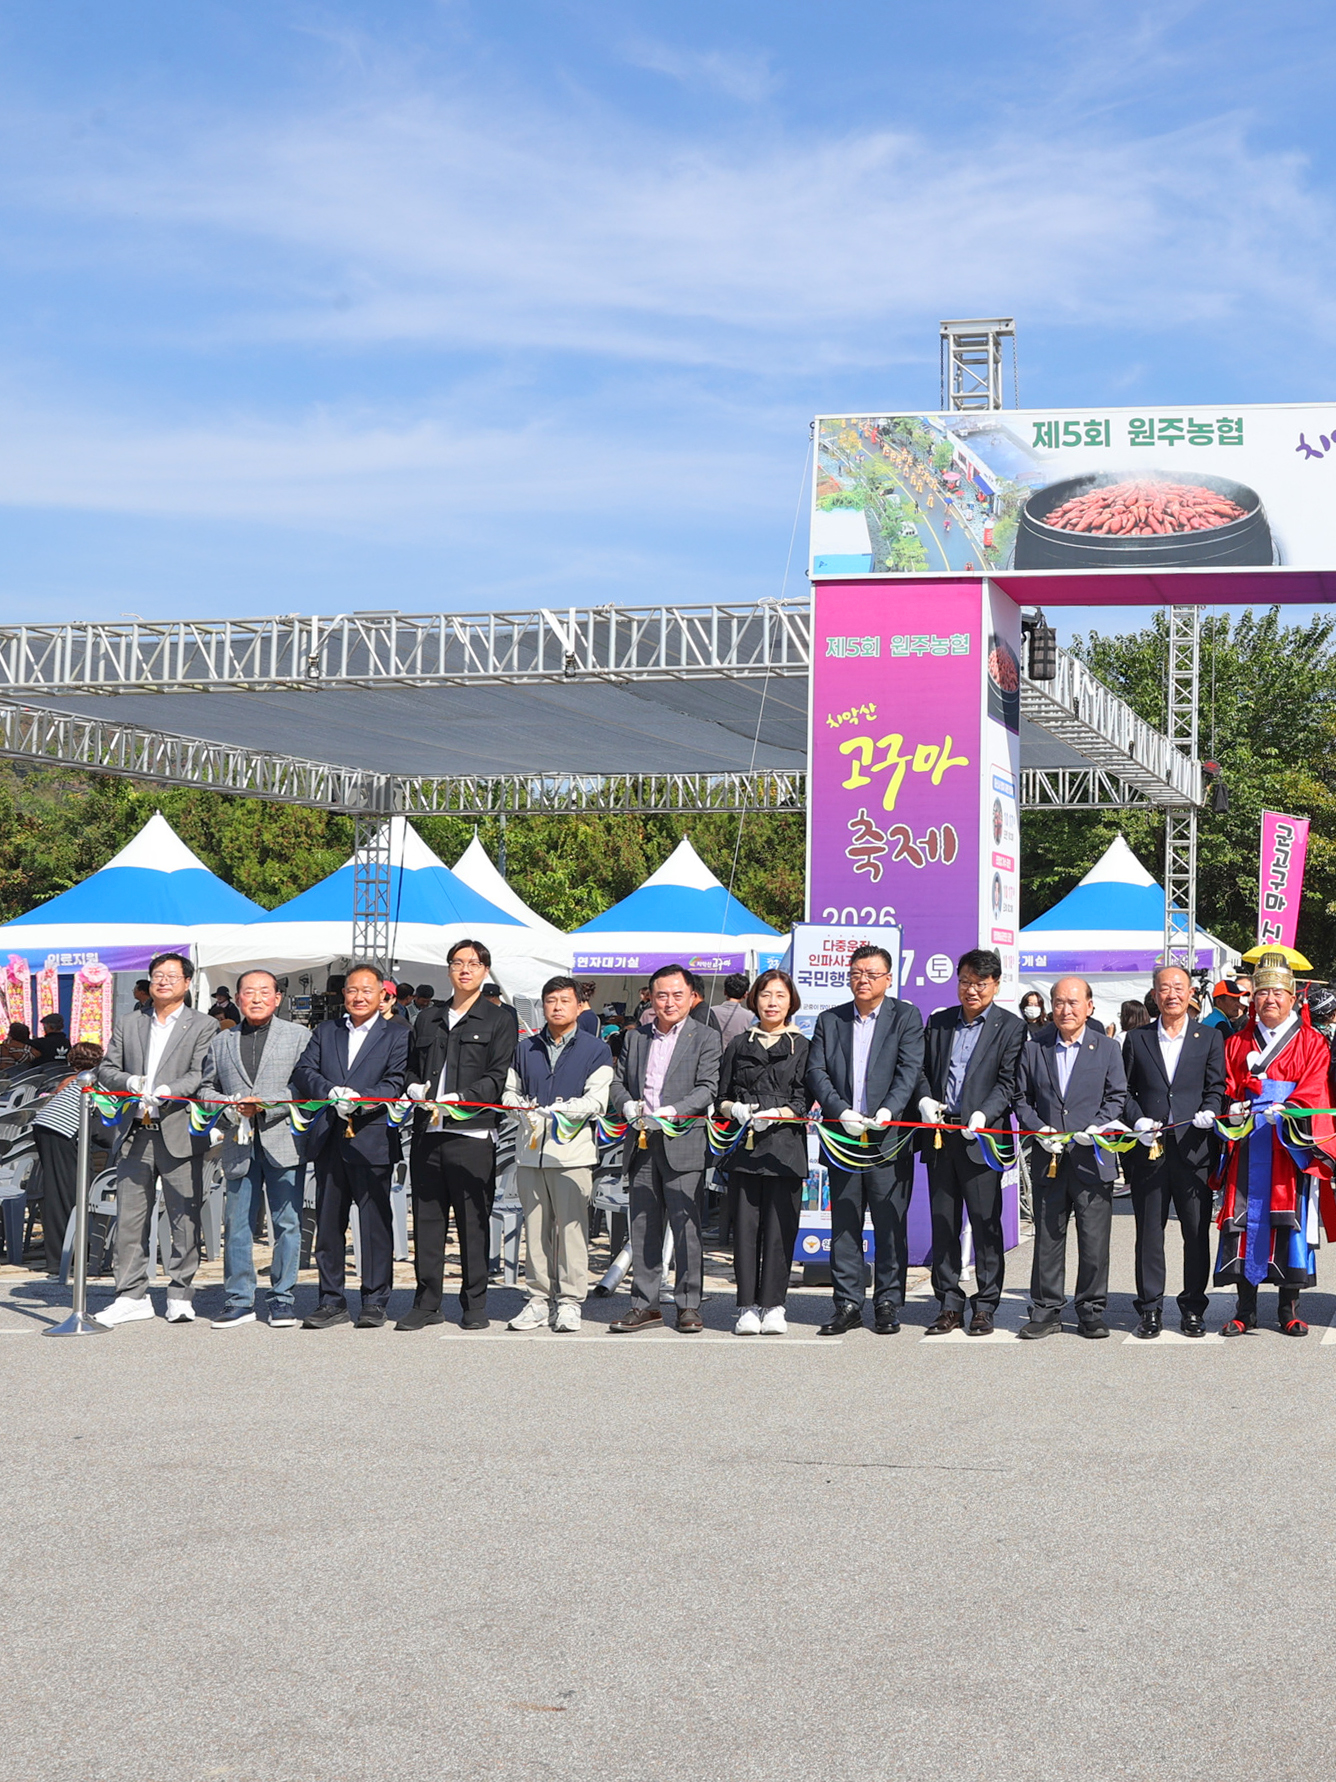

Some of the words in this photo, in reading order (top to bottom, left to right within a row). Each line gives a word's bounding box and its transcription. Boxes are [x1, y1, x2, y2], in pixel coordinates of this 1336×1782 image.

[1032, 419, 1111, 449] 제5회
[1128, 417, 1244, 447] 원주농협
[826, 636, 880, 658] 제5회
[890, 633, 970, 657] 원주농협
[826, 703, 877, 728] 치악산
[839, 733, 970, 812] 고구마
[845, 808, 958, 882] 축제
[1264, 823, 1294, 912] 군고구마
[1018, 955, 1047, 967] 게실
[798, 970, 851, 987] 국민행
